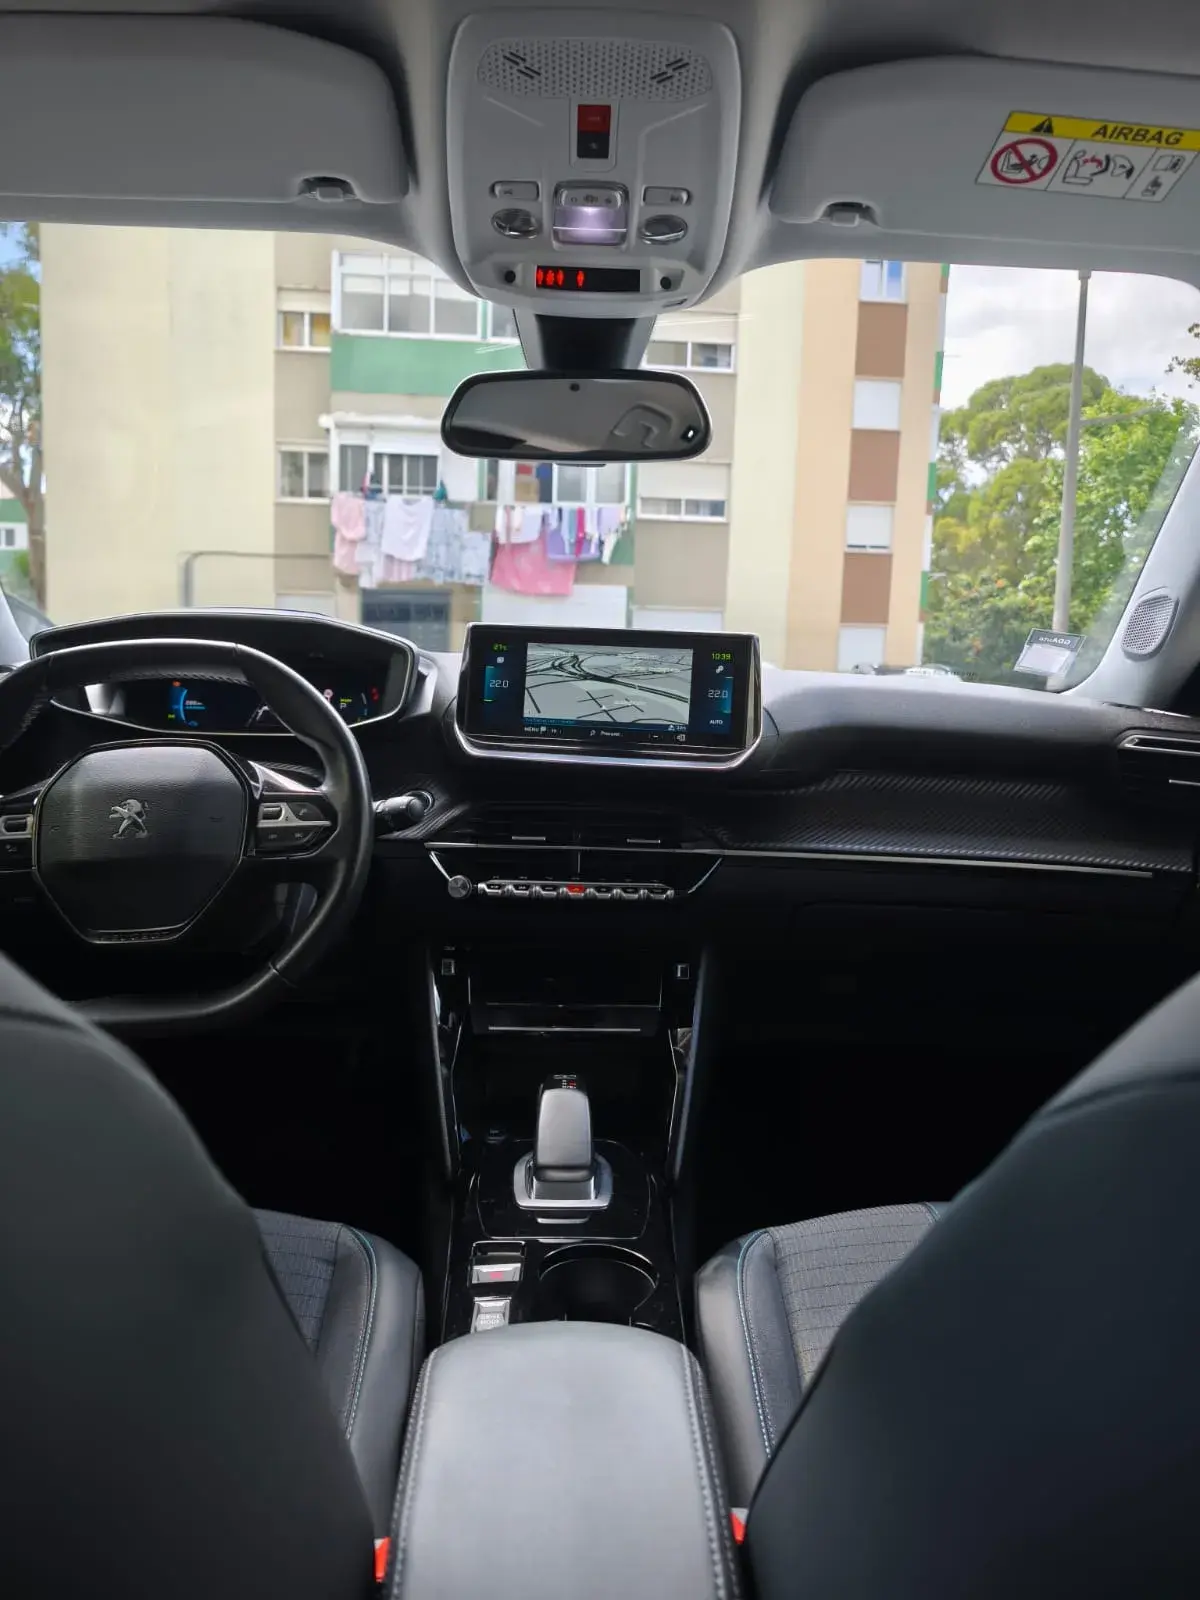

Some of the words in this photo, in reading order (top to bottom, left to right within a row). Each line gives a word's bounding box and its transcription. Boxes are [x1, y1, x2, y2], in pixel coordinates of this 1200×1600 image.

[1091, 124, 1184, 146] AIRBAG
[711, 652, 731, 661] 10:39
[489, 679, 509, 688] 22.0
[708, 689, 729, 699] 22.0
